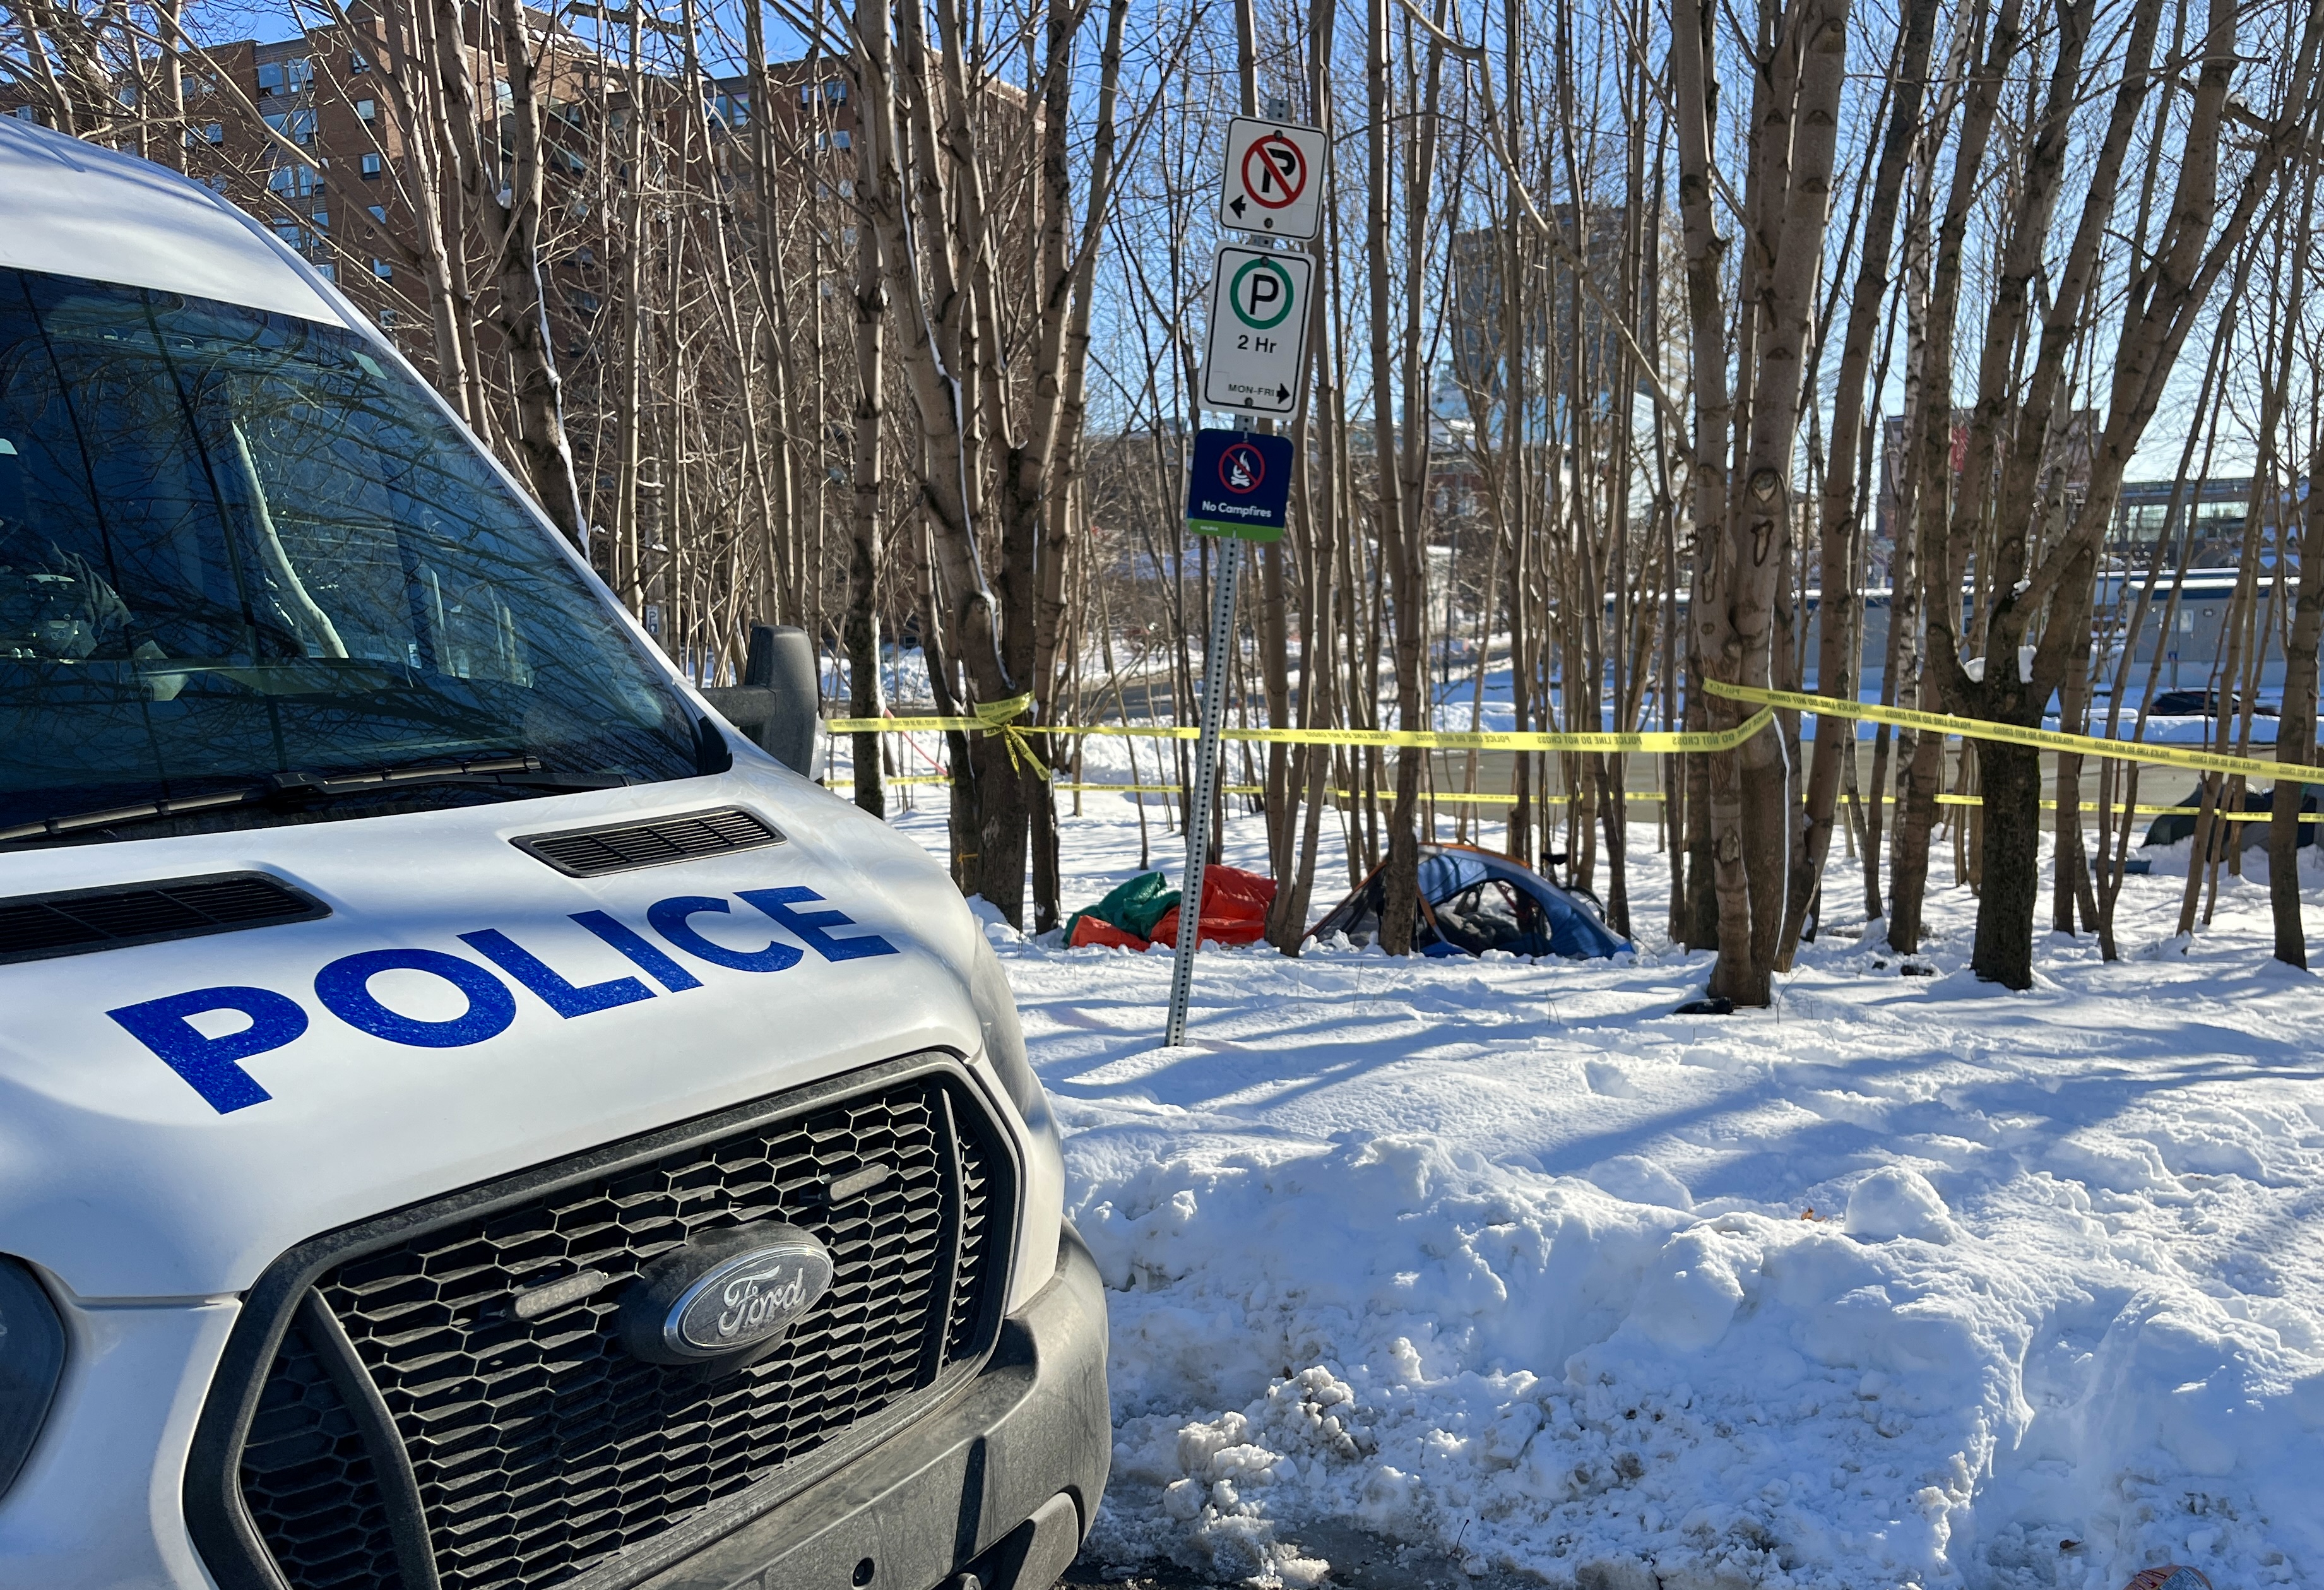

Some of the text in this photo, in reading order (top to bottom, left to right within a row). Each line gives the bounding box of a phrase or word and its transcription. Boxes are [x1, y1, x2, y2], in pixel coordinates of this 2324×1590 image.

[1250, 273, 1279, 315] P
[1237, 335, 1277, 353] 2 Hr
[1228, 384, 1275, 397] MON-FRI
[1202, 500, 1272, 518] No Campfires
[105, 885, 900, 1115] POLICE
[717, 1264, 806, 1337] Ford
